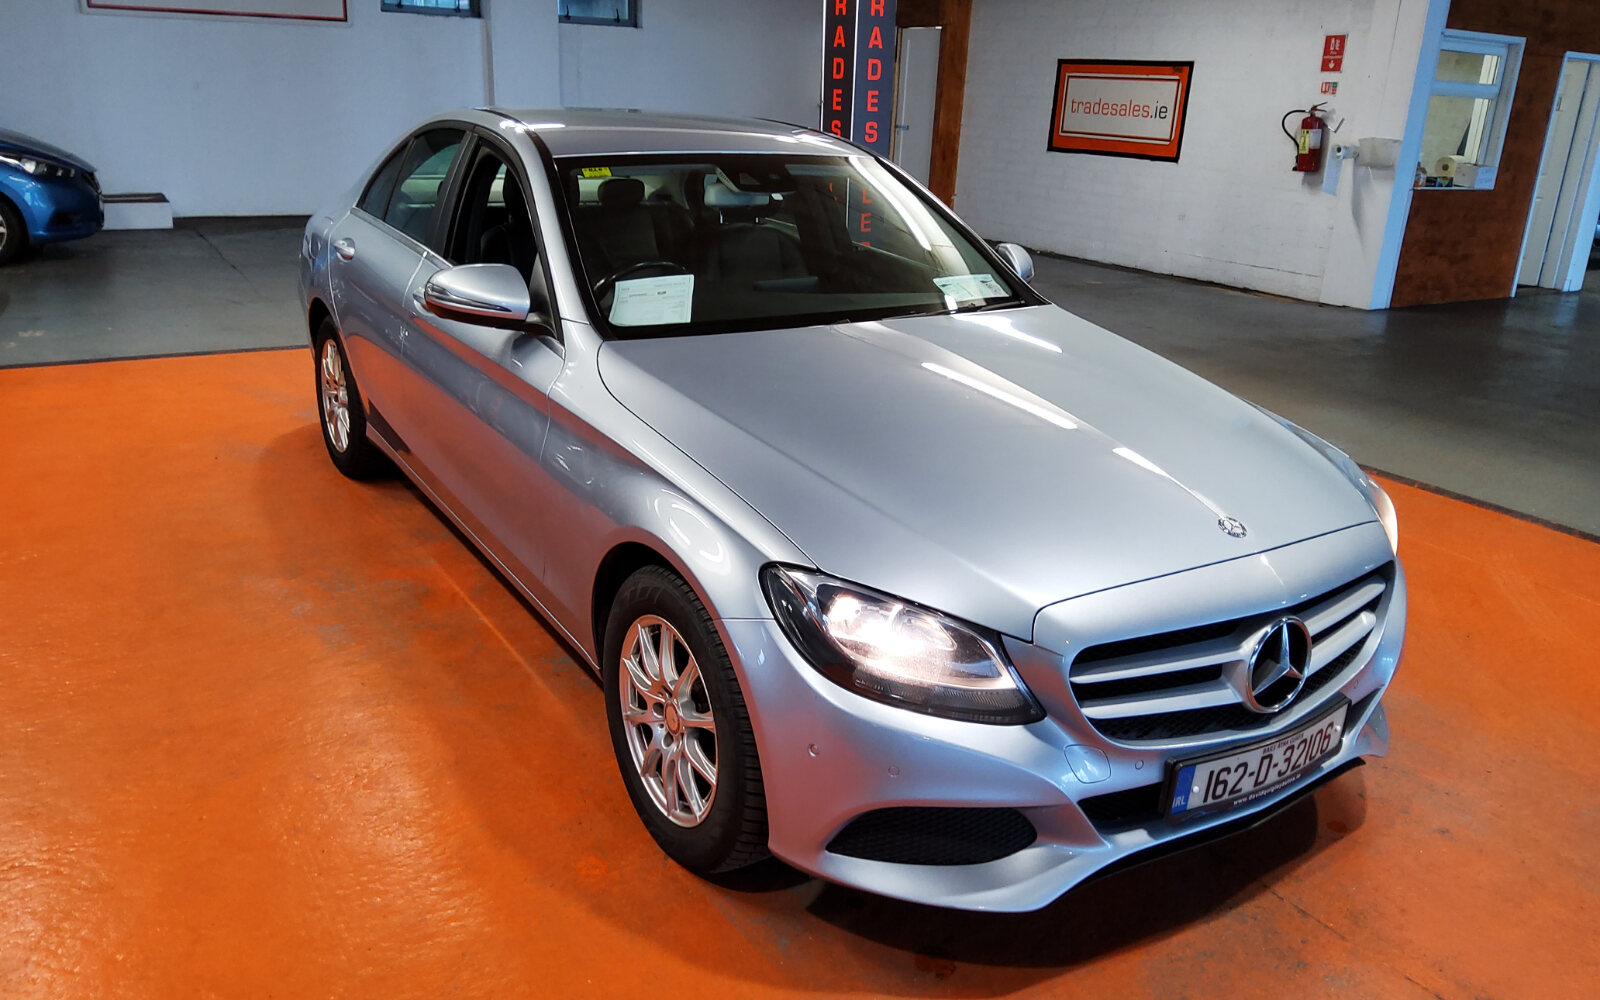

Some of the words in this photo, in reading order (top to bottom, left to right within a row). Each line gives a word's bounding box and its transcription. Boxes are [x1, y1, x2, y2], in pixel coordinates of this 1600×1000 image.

[1070, 98, 1168, 119] tradesales.ie
[1203, 721, 1334, 803] 162-D-32106
[1172, 795, 1186, 808] IRL
